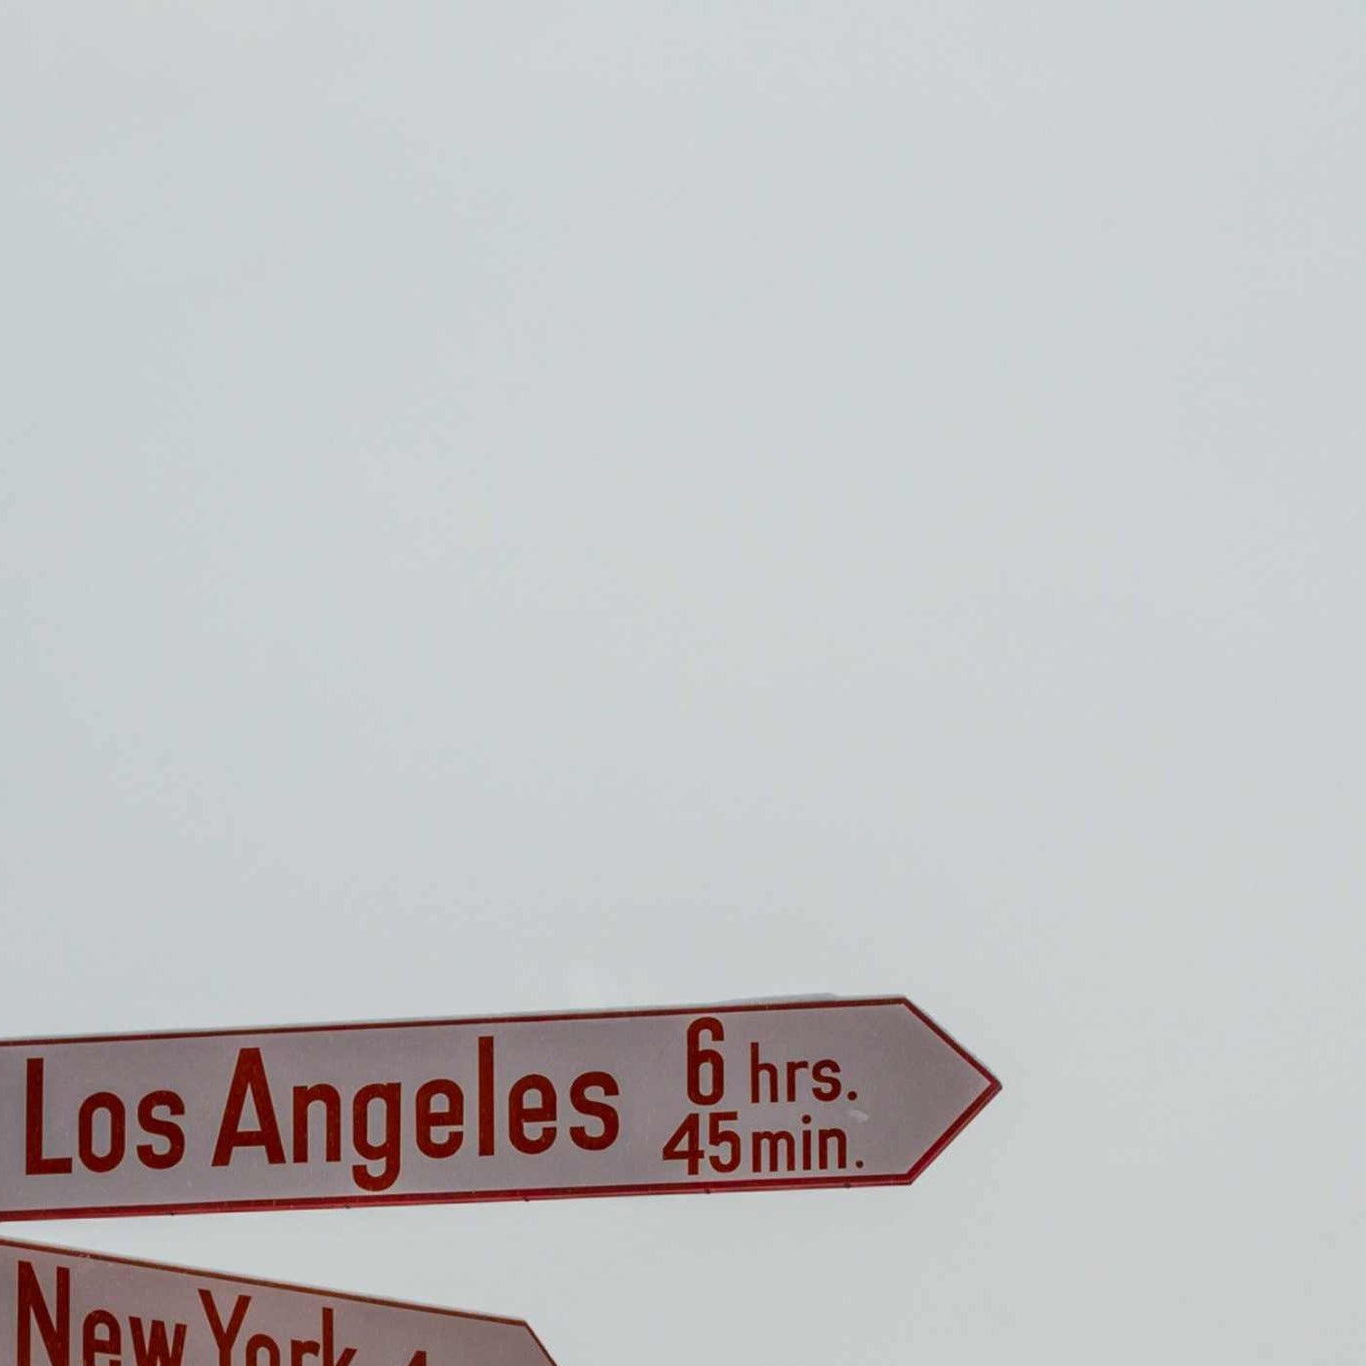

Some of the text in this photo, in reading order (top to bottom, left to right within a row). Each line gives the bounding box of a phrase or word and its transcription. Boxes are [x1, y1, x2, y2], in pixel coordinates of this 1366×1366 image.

[26, 1017, 857, 1191] Los Angeles 6 hrs.
[663, 1111, 863, 1175] 45 min.
